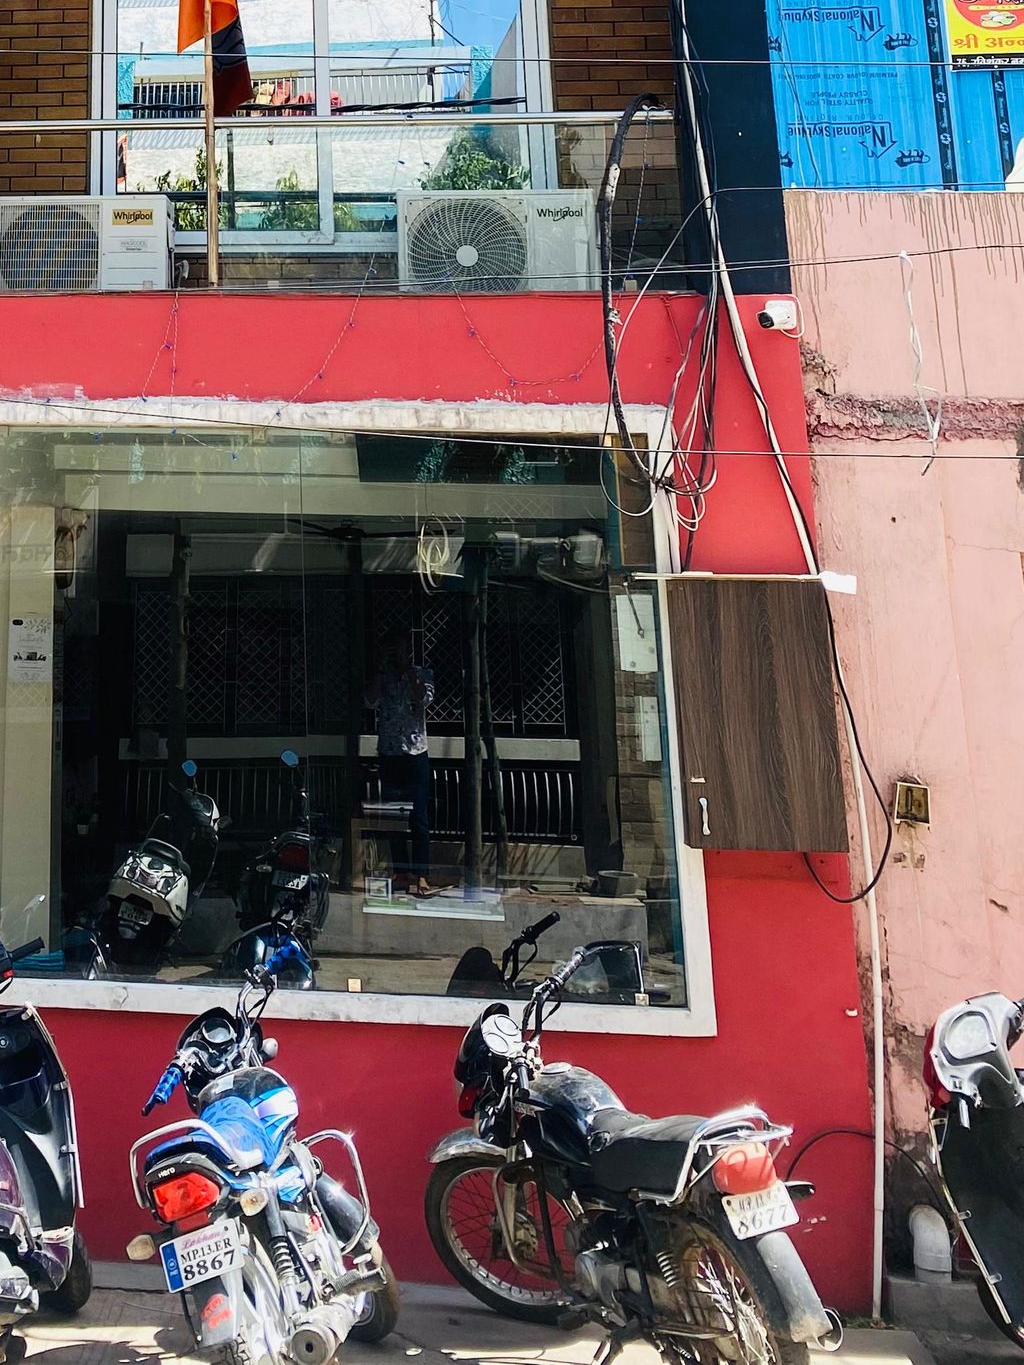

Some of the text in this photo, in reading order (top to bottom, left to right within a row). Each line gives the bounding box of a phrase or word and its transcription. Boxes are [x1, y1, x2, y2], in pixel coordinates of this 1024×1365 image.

[780, 9, 875, 32] National Skyblu
[953, 34, 979, 48] श्री
[832, 125, 886, 147] National
[113, 210, 153, 224] Whirlpool
[536, 206, 583, 222] Whirlpool
[158, 1166, 176, 1178] Hero
[183, 1249, 235, 1281] 8867
